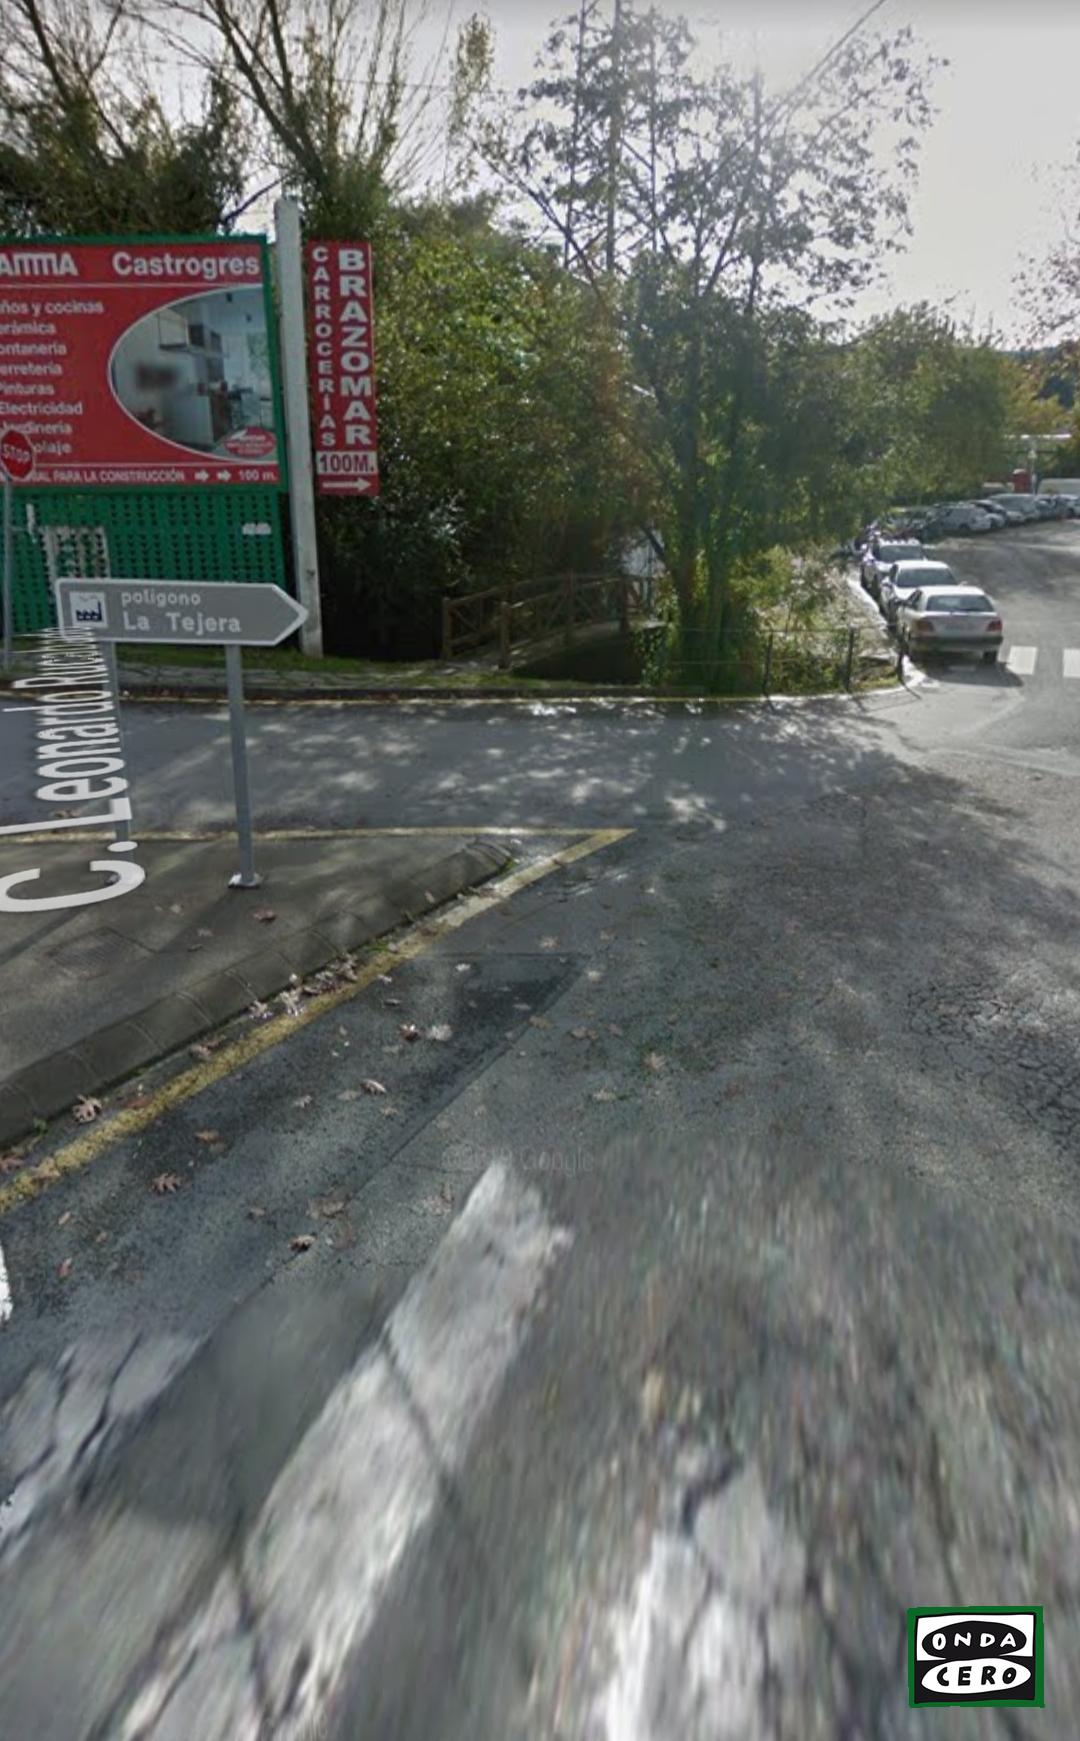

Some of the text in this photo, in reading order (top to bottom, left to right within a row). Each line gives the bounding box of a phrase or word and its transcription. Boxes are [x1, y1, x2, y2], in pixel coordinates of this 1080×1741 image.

[112, 252, 261, 280] Castrogres
[32, 302, 42, 318] y
[45, 300, 105, 315] cocinas
[338, 249, 372, 446] BRAZOMAR
[318, 453, 376, 473] 100M.
[83, 469, 98, 482] LA
[238, 470, 261, 482] 100
[123, 611, 242, 637] La Tejera
